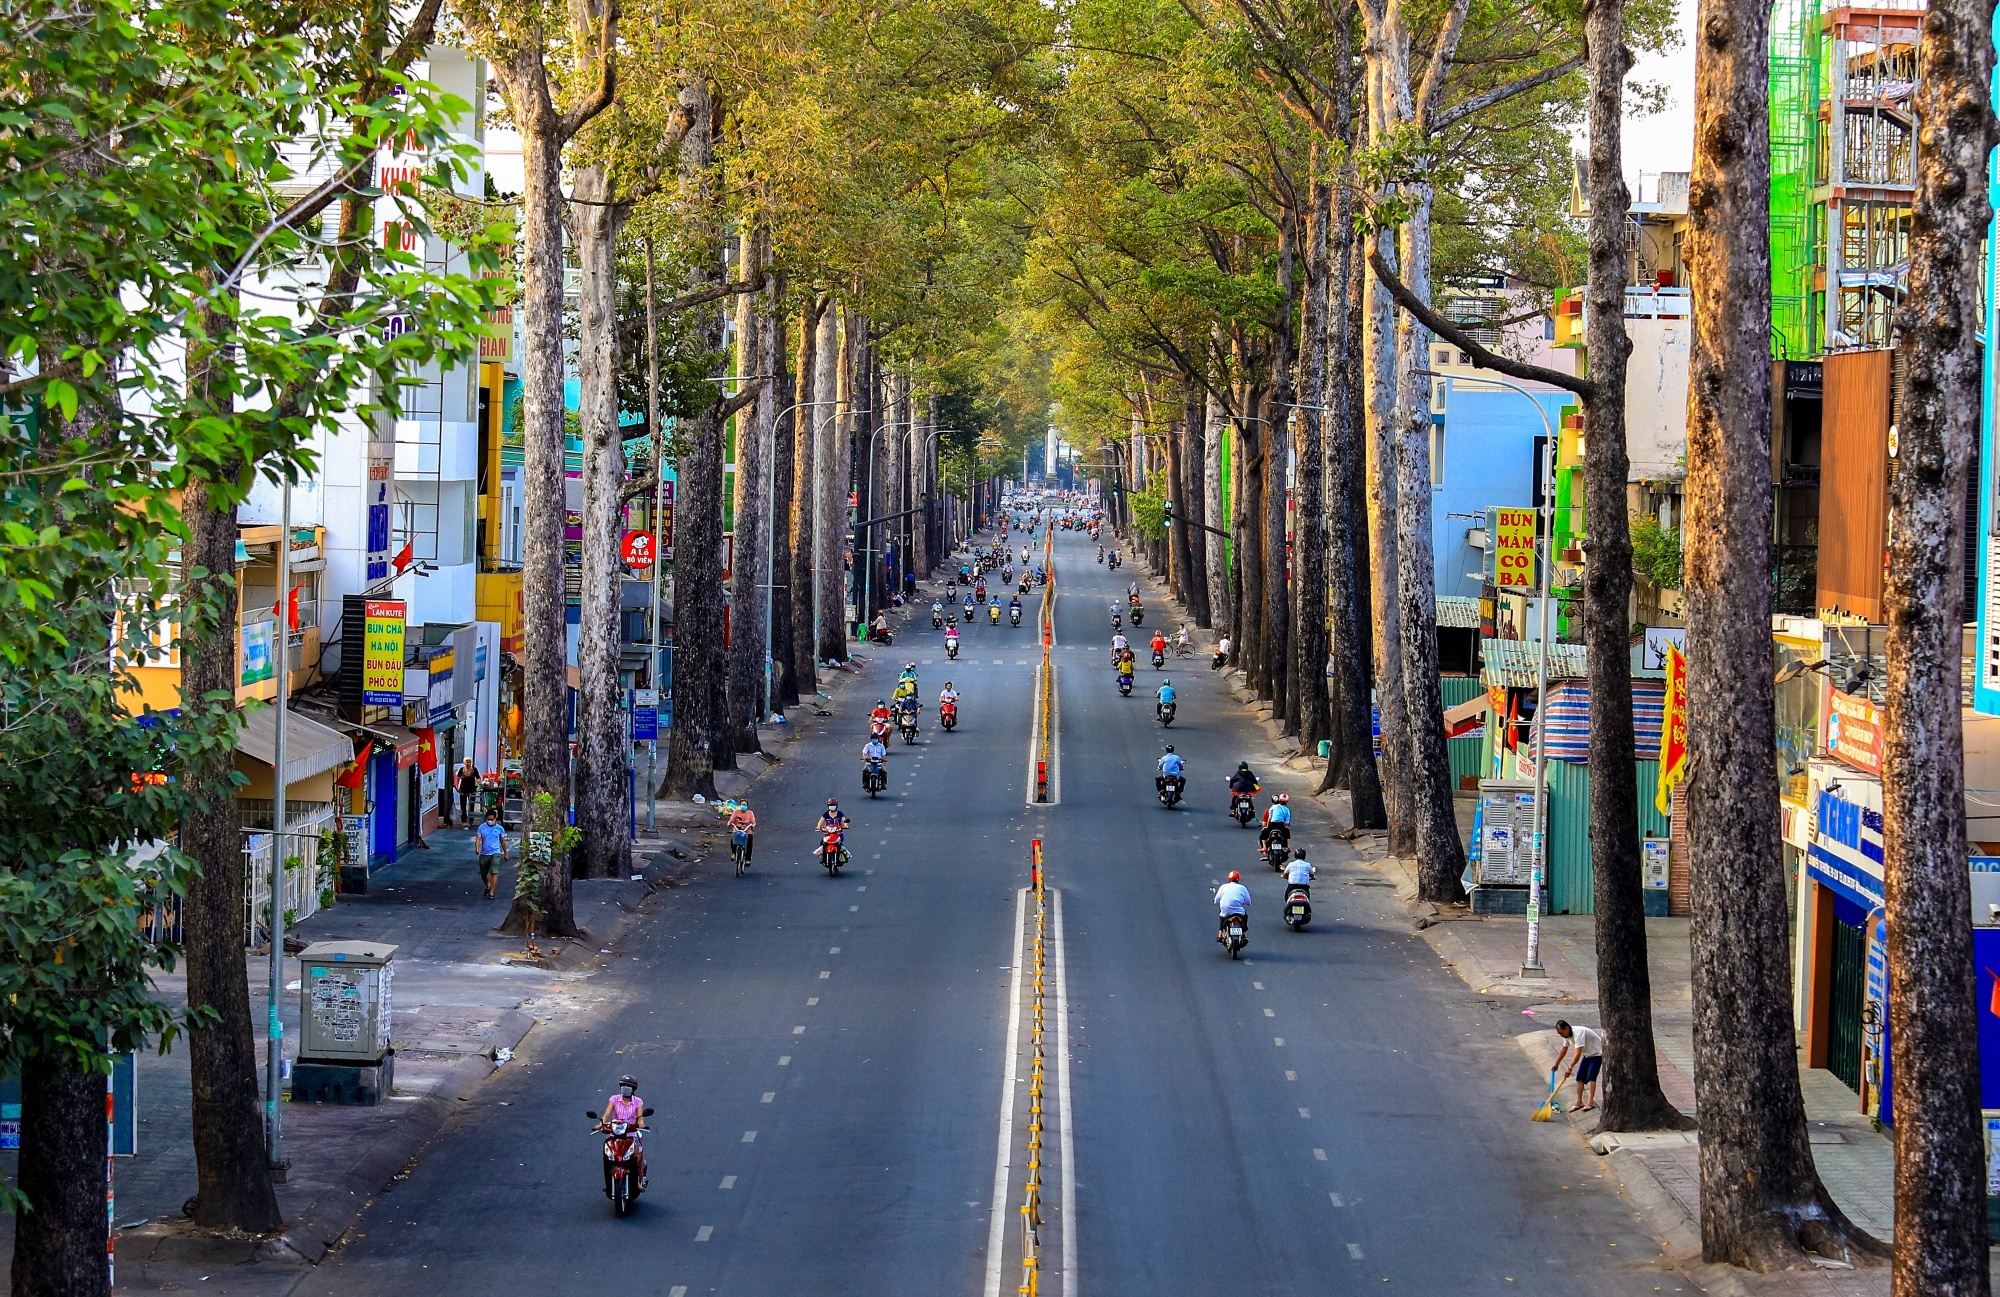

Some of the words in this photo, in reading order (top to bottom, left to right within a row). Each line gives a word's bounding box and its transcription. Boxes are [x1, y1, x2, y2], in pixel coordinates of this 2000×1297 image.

[480, 337, 506, 356] GIAN
[1500, 510, 1533, 526] BÚN
[1498, 529, 1534, 549] MẮM
[637, 556, 652, 564] VIÊN
[1501, 552, 1529, 568] CÔ
[1500, 572, 1529, 586] BA
[368, 621, 383, 633] BÚN
[385, 640, 398, 654] NỘI
[367, 657, 383, 670] BÚN
[386, 658, 401, 673] ĐẬU
[369, 674, 385, 687] PHỐ
